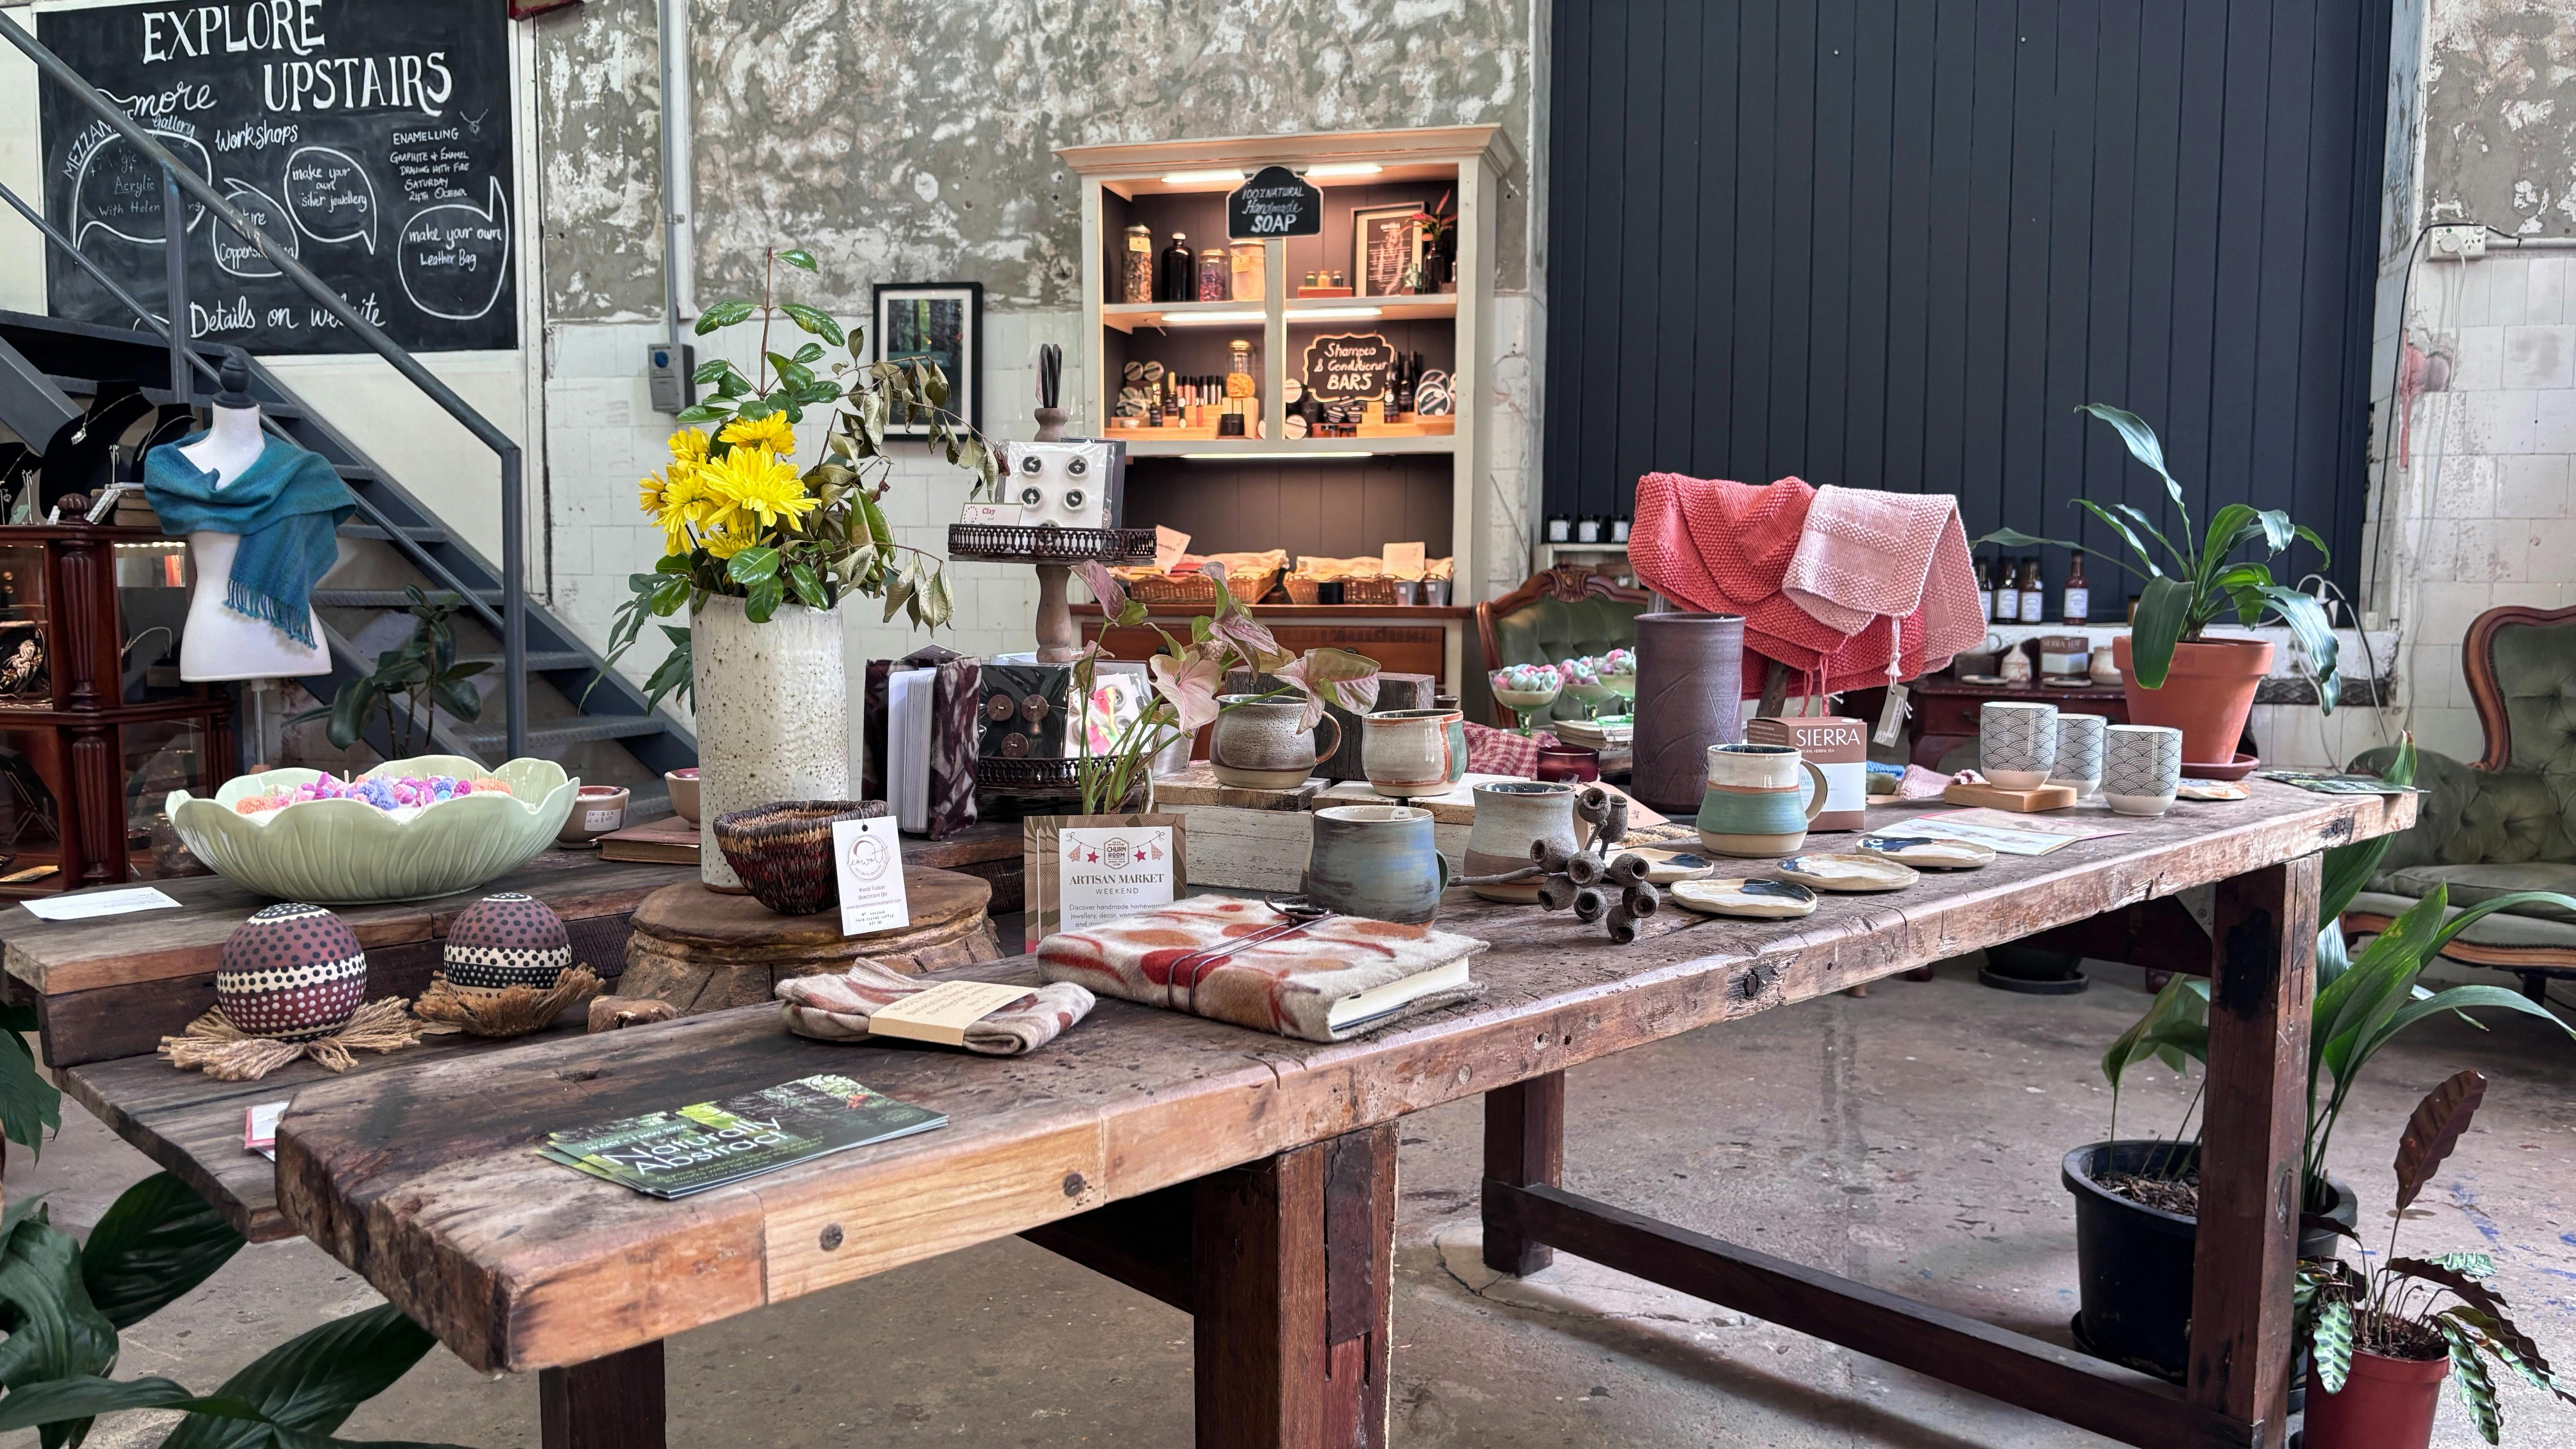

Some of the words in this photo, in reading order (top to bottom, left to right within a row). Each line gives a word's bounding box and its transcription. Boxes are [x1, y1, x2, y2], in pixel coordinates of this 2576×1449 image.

[143, 0, 325, 64] EXPLORE
[264, 52, 452, 117] UPSTAIRS
[126, 81, 217, 116] more
[393, 127, 459, 145] ENAMELLING
[389, 151, 428, 165] GRAPHITE
[432, 163, 451, 174] WITH
[453, 161, 470, 173] FIRE
[292, 164, 322, 181] make
[329, 168, 350, 183] your
[115, 174, 155, 197] Acrylic
[316, 181, 336, 190] own
[404, 177, 448, 192] SATURDAY
[130, 202, 161, 213] Helen
[302, 191, 326, 207] silver
[328, 190, 368, 213] jewellery
[1241, 199, 1304, 215] Handmade
[1250, 213, 1297, 233] SOAP
[409, 223, 442, 242] make
[446, 227, 473, 250] your
[476, 228, 502, 241] own
[420, 249, 456, 266] Leather
[458, 248, 477, 272] Bag
[189, 295, 256, 338] Details
[267, 307, 300, 329] on
[310, 292, 386, 327] weite
[1324, 342, 1377, 360] Shampoo
[1326, 373, 1373, 391] BARS
[1795, 728, 1860, 747] SIERRA
[1069, 874, 1116, 885] ARTISAN
[1118, 873, 1164, 883] MARKET
[600, 1117, 782, 1165] Naturally
[634, 1129, 789, 1175] Abstract
